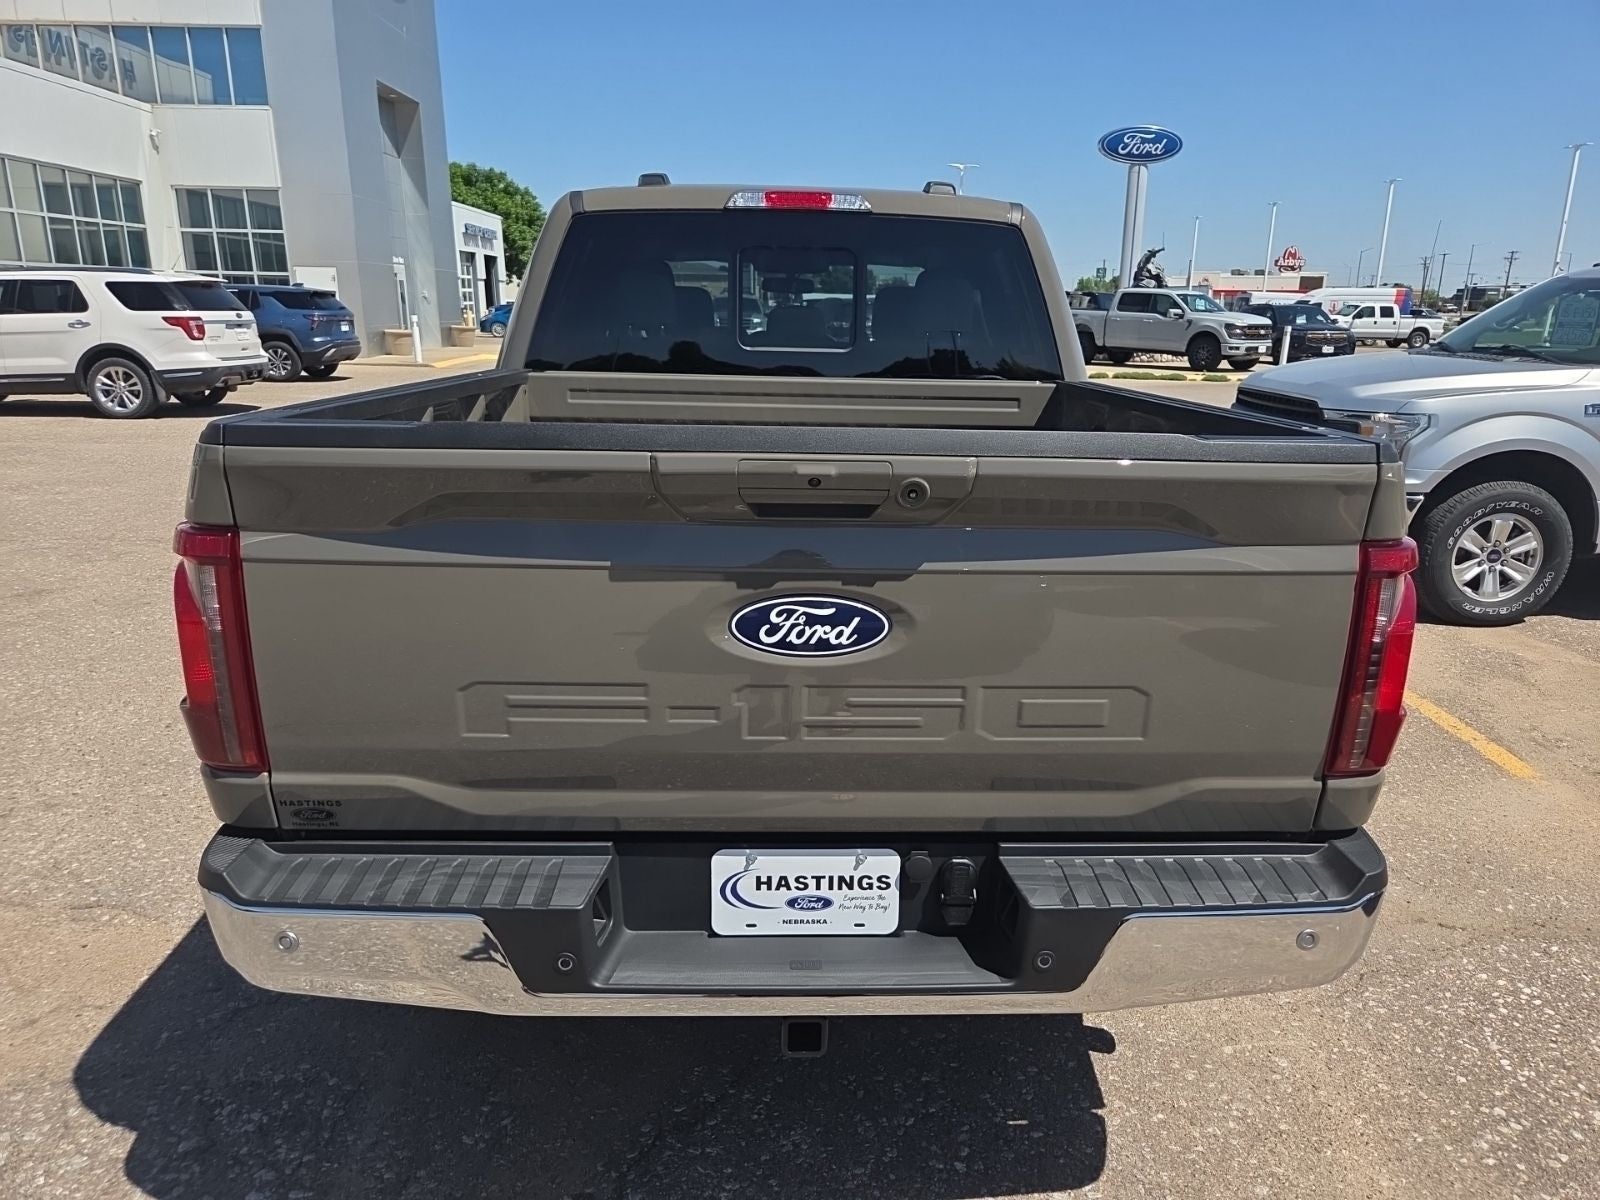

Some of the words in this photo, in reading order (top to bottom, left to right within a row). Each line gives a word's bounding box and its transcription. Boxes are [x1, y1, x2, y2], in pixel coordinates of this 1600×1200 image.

[1118, 132, 1167, 154] Ford
[1276, 257, 1306, 268] Arby's
[1447, 501, 1544, 549] GOODYEAR
[1462, 571, 1555, 614] WRANGLER
[759, 604, 861, 645] Ford
[457, 682, 1151, 742] F-150
[280, 799, 342, 807] HASTINGS
[755, 874, 892, 892] HASTINGS
[794, 897, 824, 909] Ford
[843, 894, 875, 903] Experience
[853, 902, 867, 914] Way
